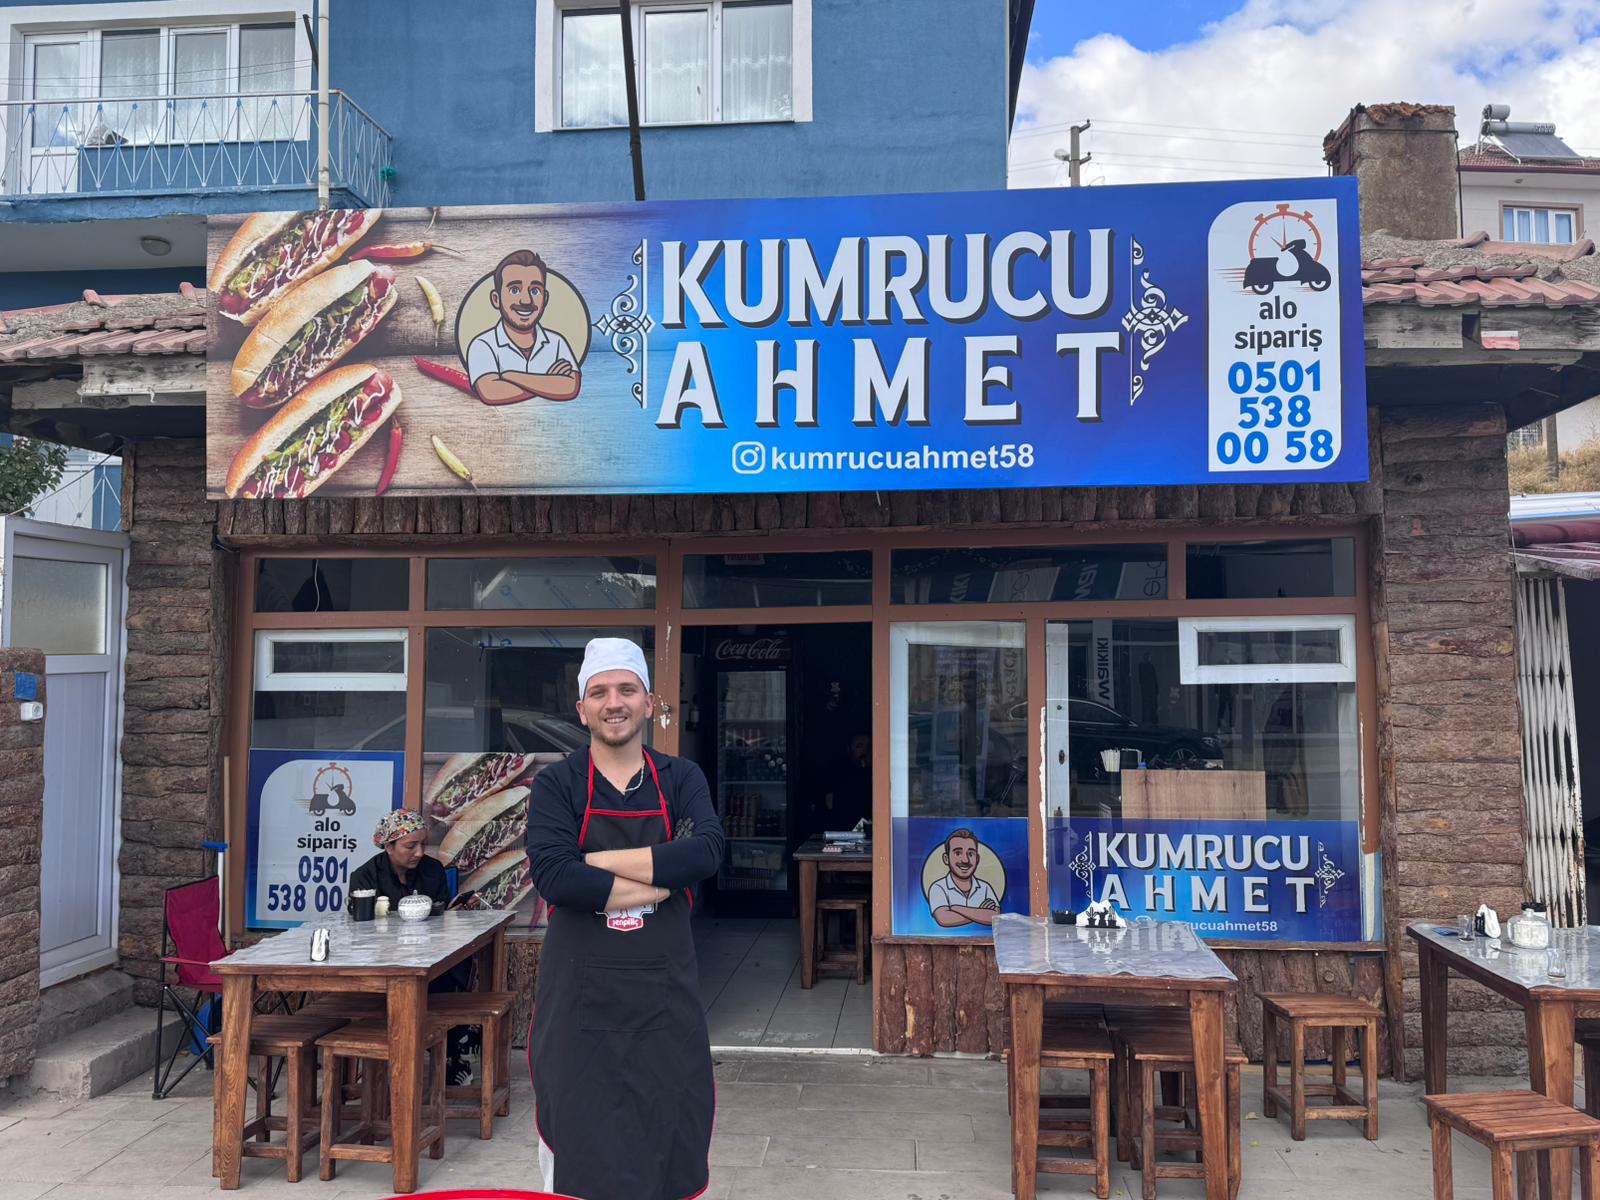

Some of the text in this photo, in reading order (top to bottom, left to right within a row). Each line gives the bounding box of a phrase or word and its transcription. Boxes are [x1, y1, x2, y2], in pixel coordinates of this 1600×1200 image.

[660, 228, 1116, 328] KUMRUCU
[1259, 295, 1298, 320] alo
[1234, 323, 1323, 355] sipariş
[655, 331, 1125, 429] AHMET
[1228, 360, 1321, 394] 0501
[1238, 395, 1312, 429] 538
[771, 443, 1034, 471] kumrucuahmet58
[1216, 429, 1334, 465] 00 58
[314, 817, 341, 832] alo
[296, 833, 357, 853] sipariş
[1098, 832, 1311, 872] KUMRUCU
[298, 855, 349, 884] 0501
[267, 884, 343, 913] 538 00
[1101, 874, 1316, 913] AHMET
[1188, 920, 1278, 932] ucuahmet58
